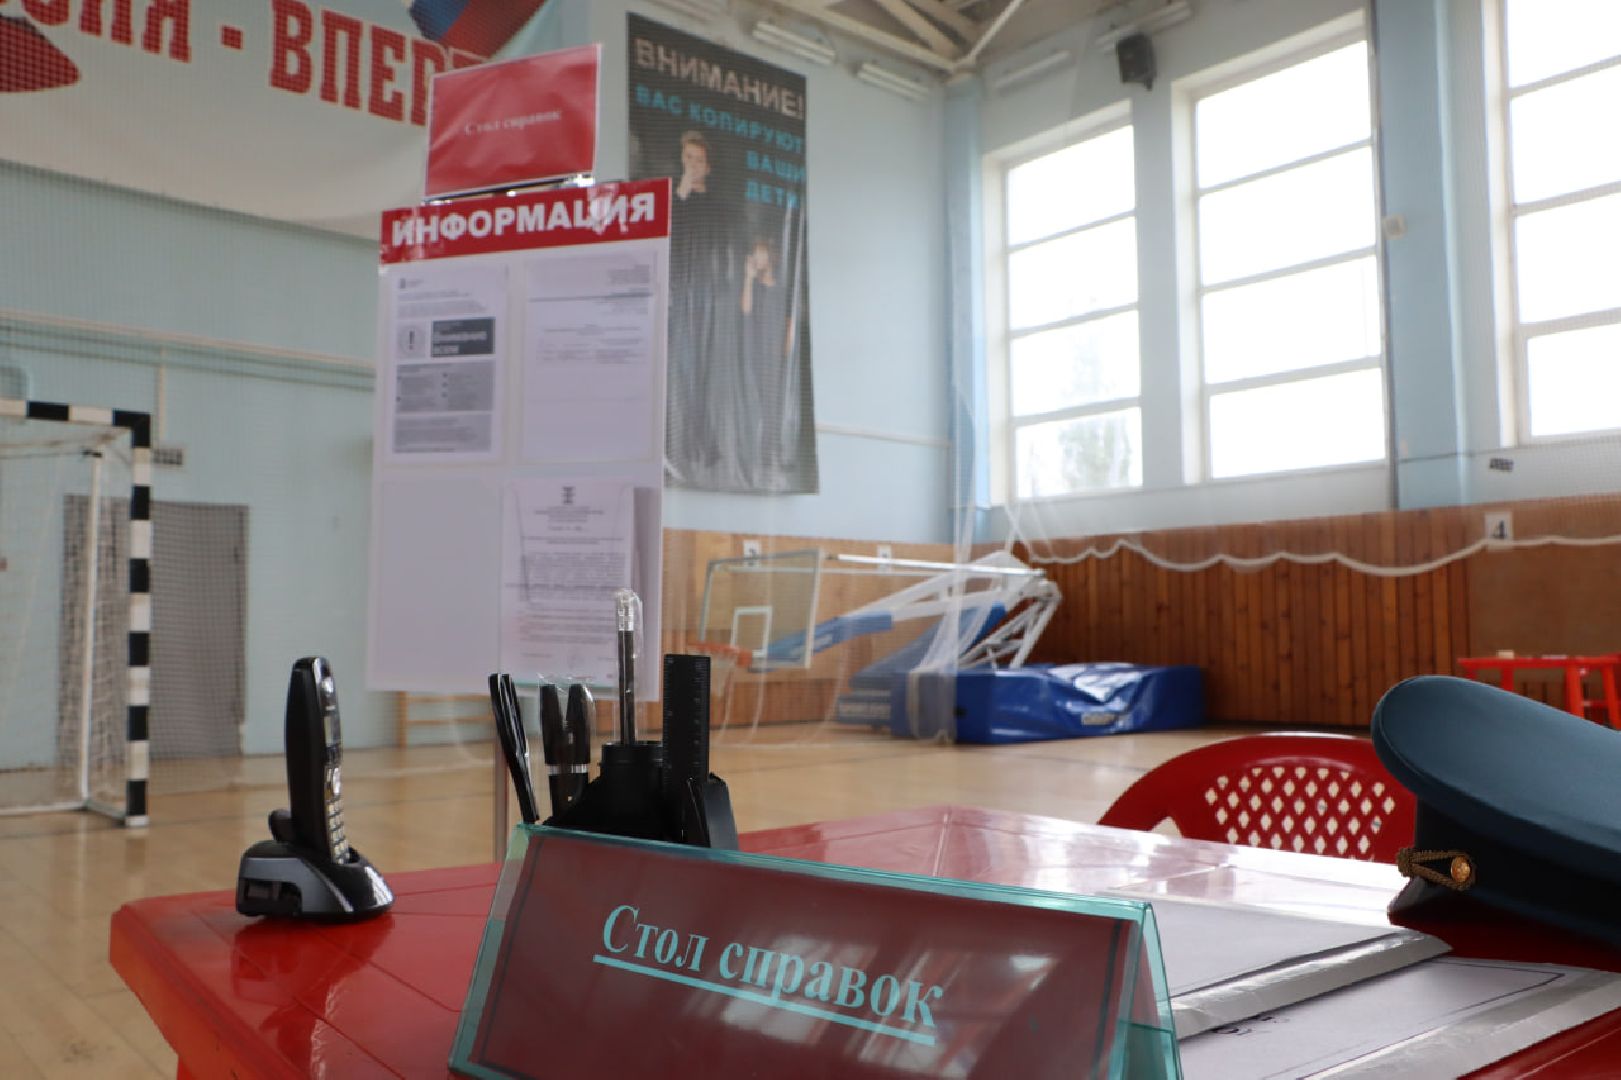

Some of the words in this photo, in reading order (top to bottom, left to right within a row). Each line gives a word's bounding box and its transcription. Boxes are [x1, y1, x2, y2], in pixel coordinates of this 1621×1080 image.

[270, 0, 485, 126] ВПЕР
[634, 37, 804, 120] ВНИМАНИЕ!
[635, 83, 683, 115] ВАС
[688, 102, 804, 154] КОПИРУЮТ
[602, 904, 709, 971] Стол
[718, 942, 943, 1028] справок
